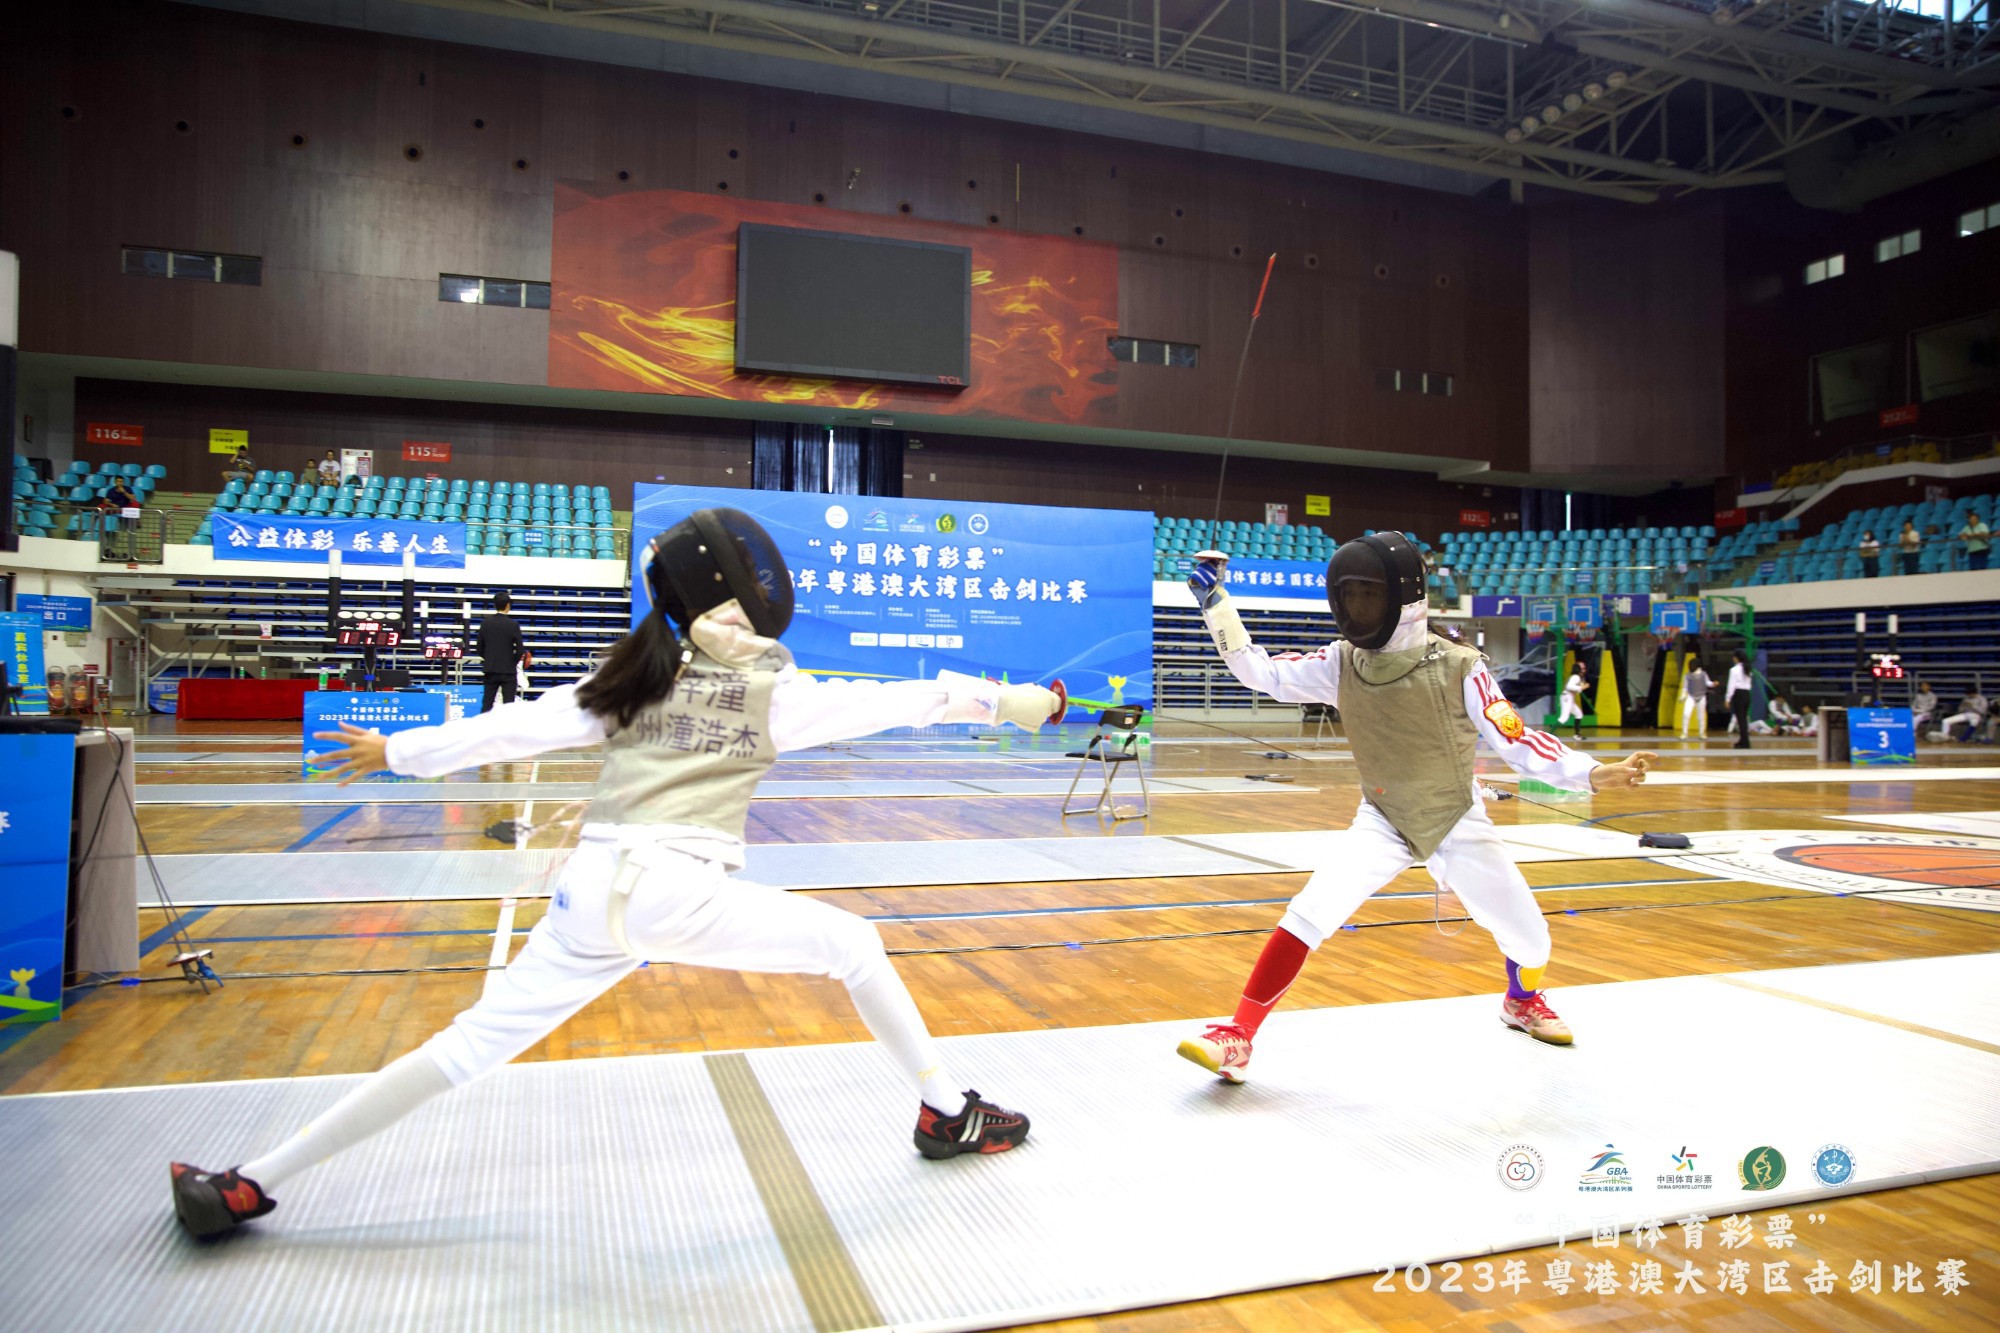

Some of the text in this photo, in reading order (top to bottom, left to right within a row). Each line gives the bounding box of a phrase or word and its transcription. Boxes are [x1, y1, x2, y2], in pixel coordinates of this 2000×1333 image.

[938, 375, 963, 386] TCL
[95, 428, 120, 440] 116
[409, 446, 431, 457] 115
[228, 525, 453, 555] 公益体彩 乐善人生
[1496, 597, 1516, 615] 广
[44, 611, 66, 621] 出口
[387, 632, 399, 646] 3
[1878, 731, 1889, 748] 3
